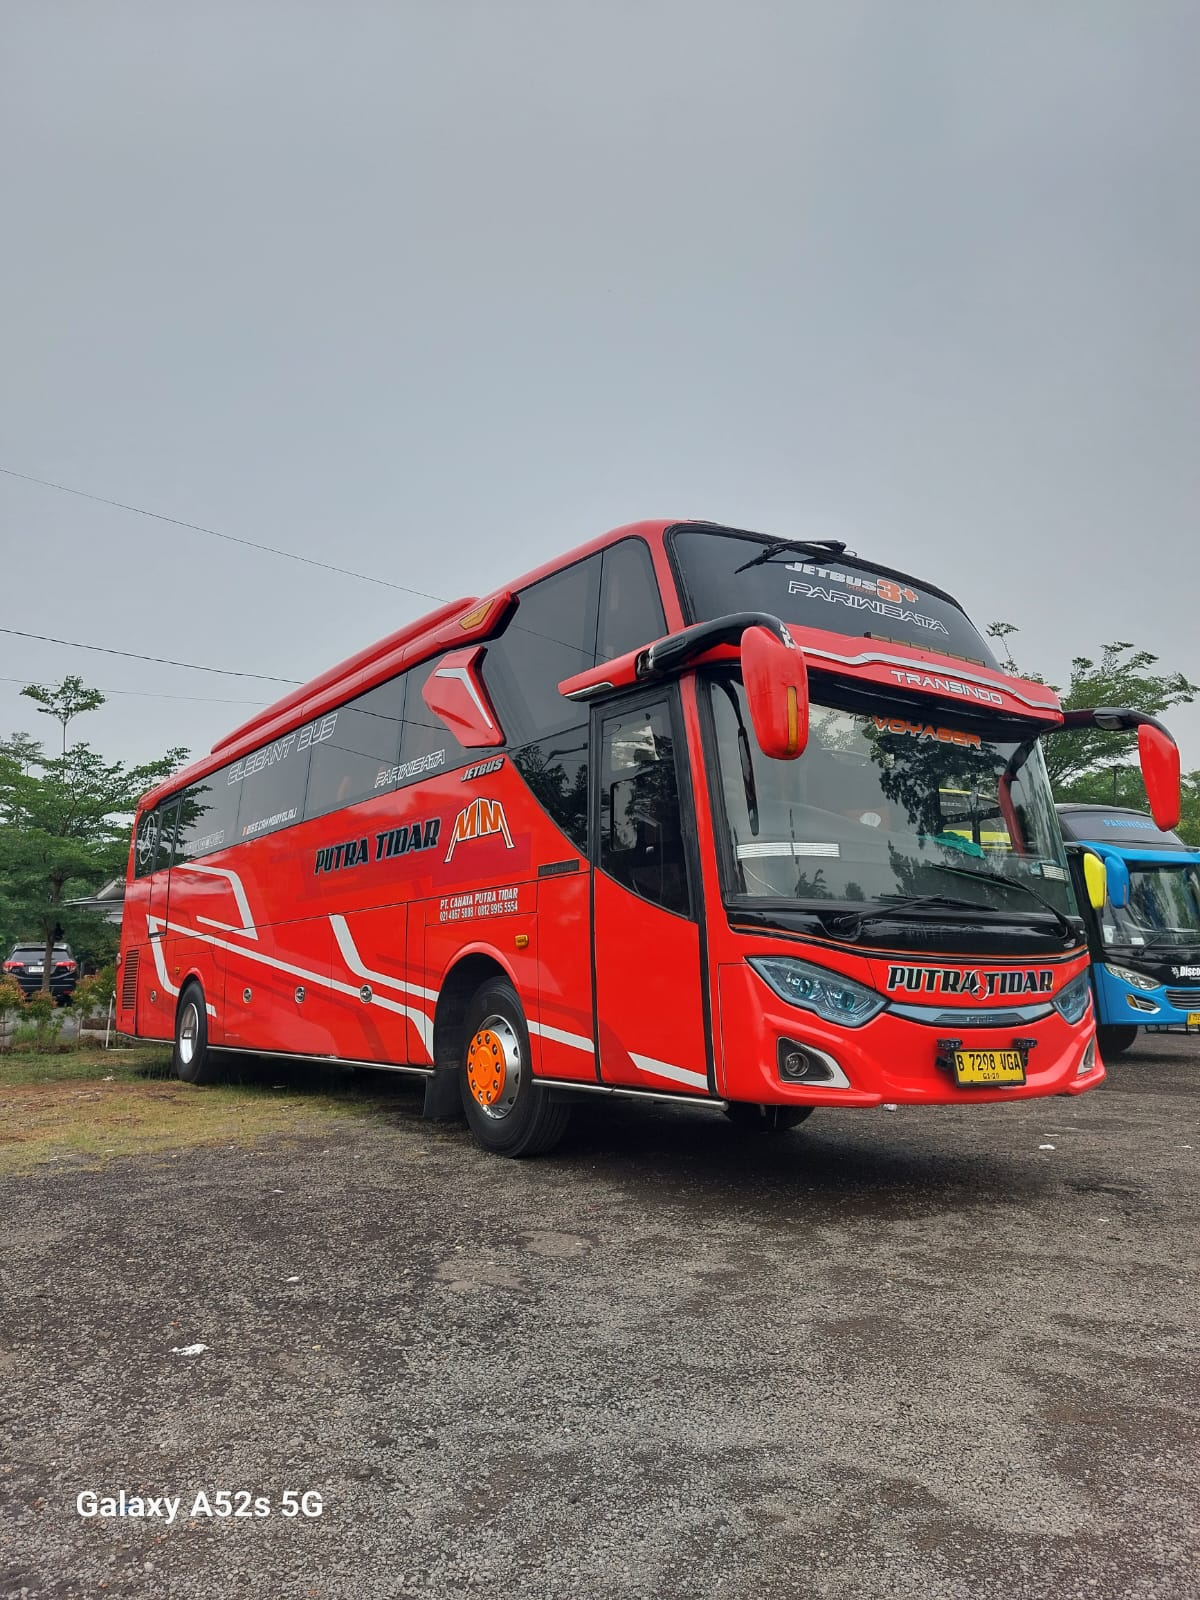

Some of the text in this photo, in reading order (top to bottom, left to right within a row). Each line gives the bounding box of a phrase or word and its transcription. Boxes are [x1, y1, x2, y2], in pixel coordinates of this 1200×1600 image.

[788, 580, 949, 636] PARIWISATA
[890, 670, 1003, 705] TRANSINDO
[873, 716, 982, 750] VOYAGER
[227, 713, 339, 786] ELEGANT BUS
[460, 758, 505, 783] JETBUS
[314, 817, 441, 875] PUTRA TIDAR
[440, 888, 518, 910] PT. CAHAYA PUTRA TIDAR
[440, 911, 448, 921] 021
[887, 965, 1054, 995] PUTRA TIDAR
[956, 1054, 964, 1071] B
[1000, 1053, 1021, 1070] VGA
